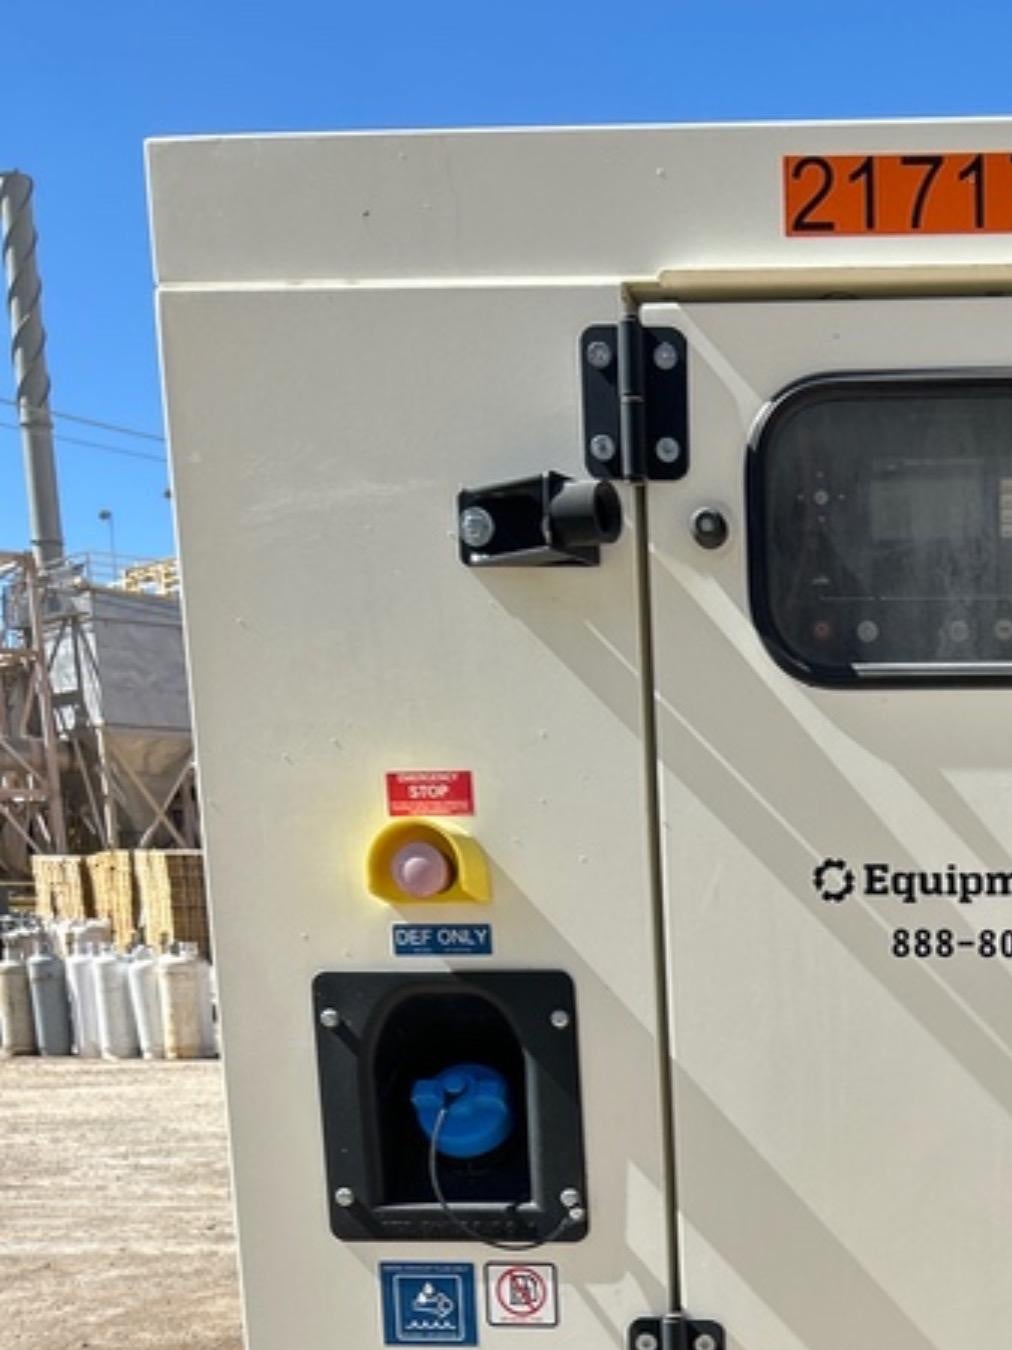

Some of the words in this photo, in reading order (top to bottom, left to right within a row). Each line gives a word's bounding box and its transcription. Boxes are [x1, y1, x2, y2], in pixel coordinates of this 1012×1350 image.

[407, 785, 450, 799] STOP
[395, 929, 433, 946] DEF
[437, 929, 487, 946] ONLY
